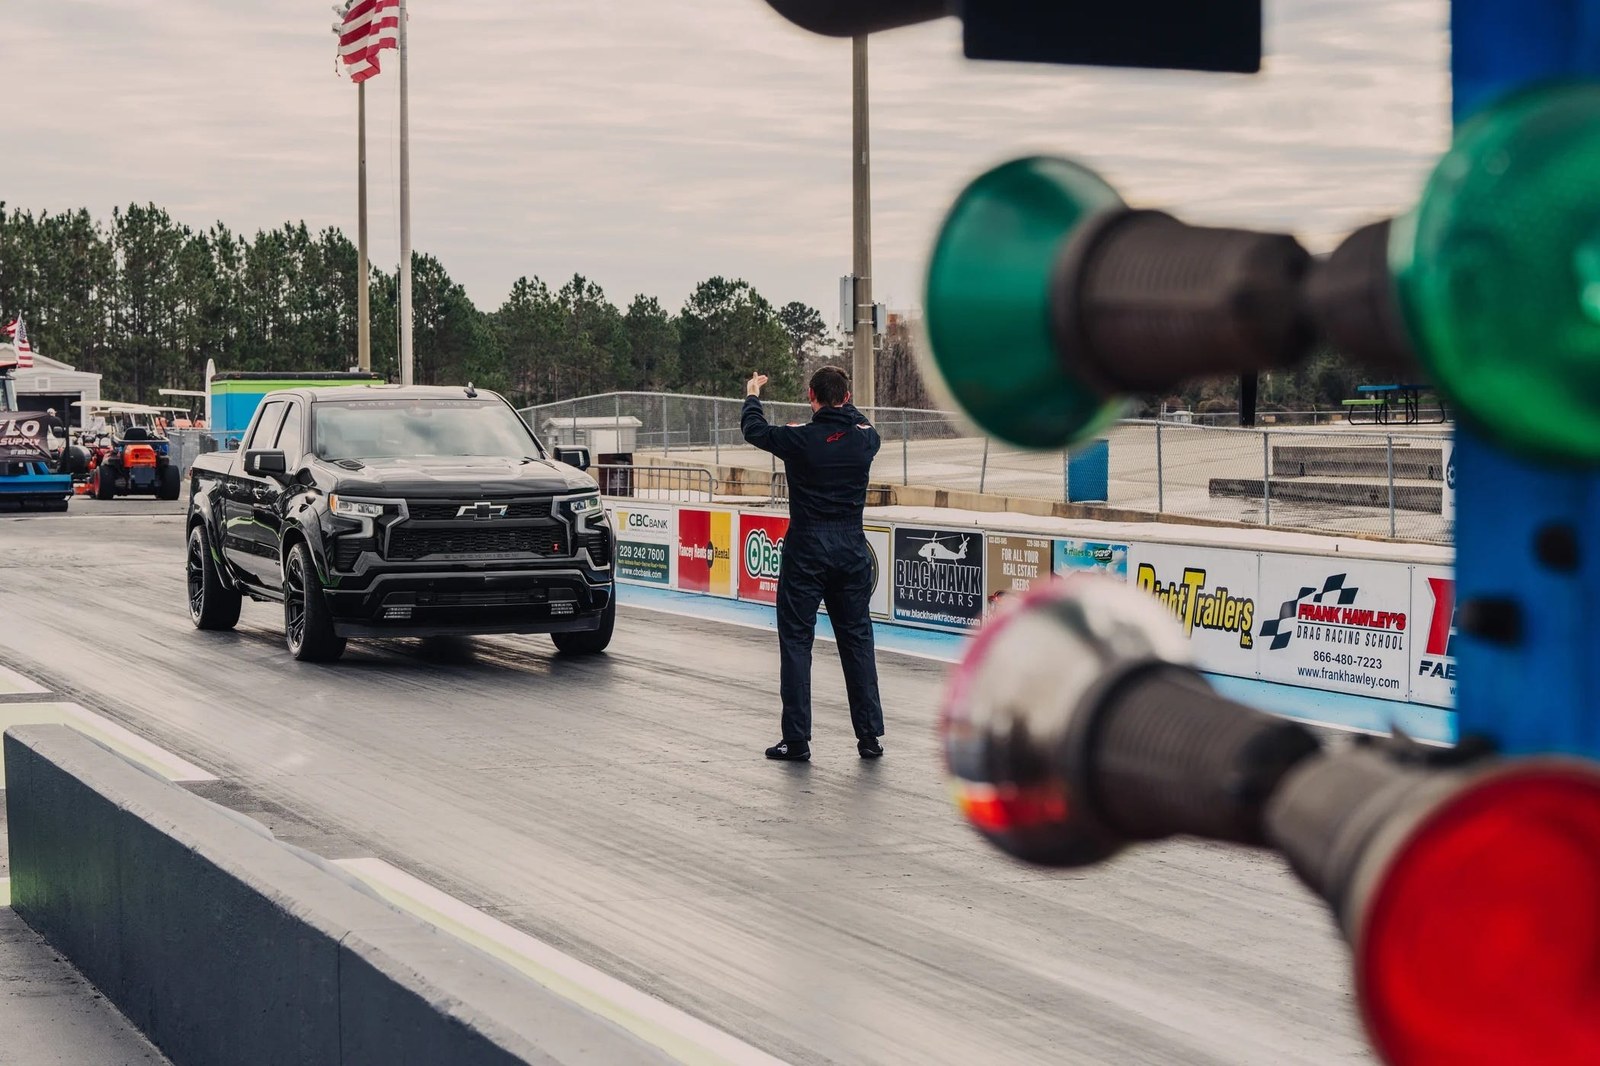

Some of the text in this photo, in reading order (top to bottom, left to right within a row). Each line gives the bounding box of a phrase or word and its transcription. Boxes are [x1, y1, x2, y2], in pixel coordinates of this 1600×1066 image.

[629, 513, 649, 528] CBC
[619, 545, 665, 561] 229 242 7600
[1001, 548, 1039, 564] FOR ALL YOUR
[621, 568, 662, 579] www.cbcbank.com
[895, 559, 981, 596] BLACKHAWK
[1002, 562, 1038, 578] REAL ESTATE
[1011, 577, 1030, 592] NEEDS
[895, 608, 981, 626] www.blackhawkracecars.com
[1298, 603, 1406, 631] FRANK HAWLEY'S
[1296, 625, 1403, 651] DRAG RACING SCHOOL
[1313, 650, 1383, 670] 866-480-7223
[1297, 665, 1400, 690] www.frankhawley.com
